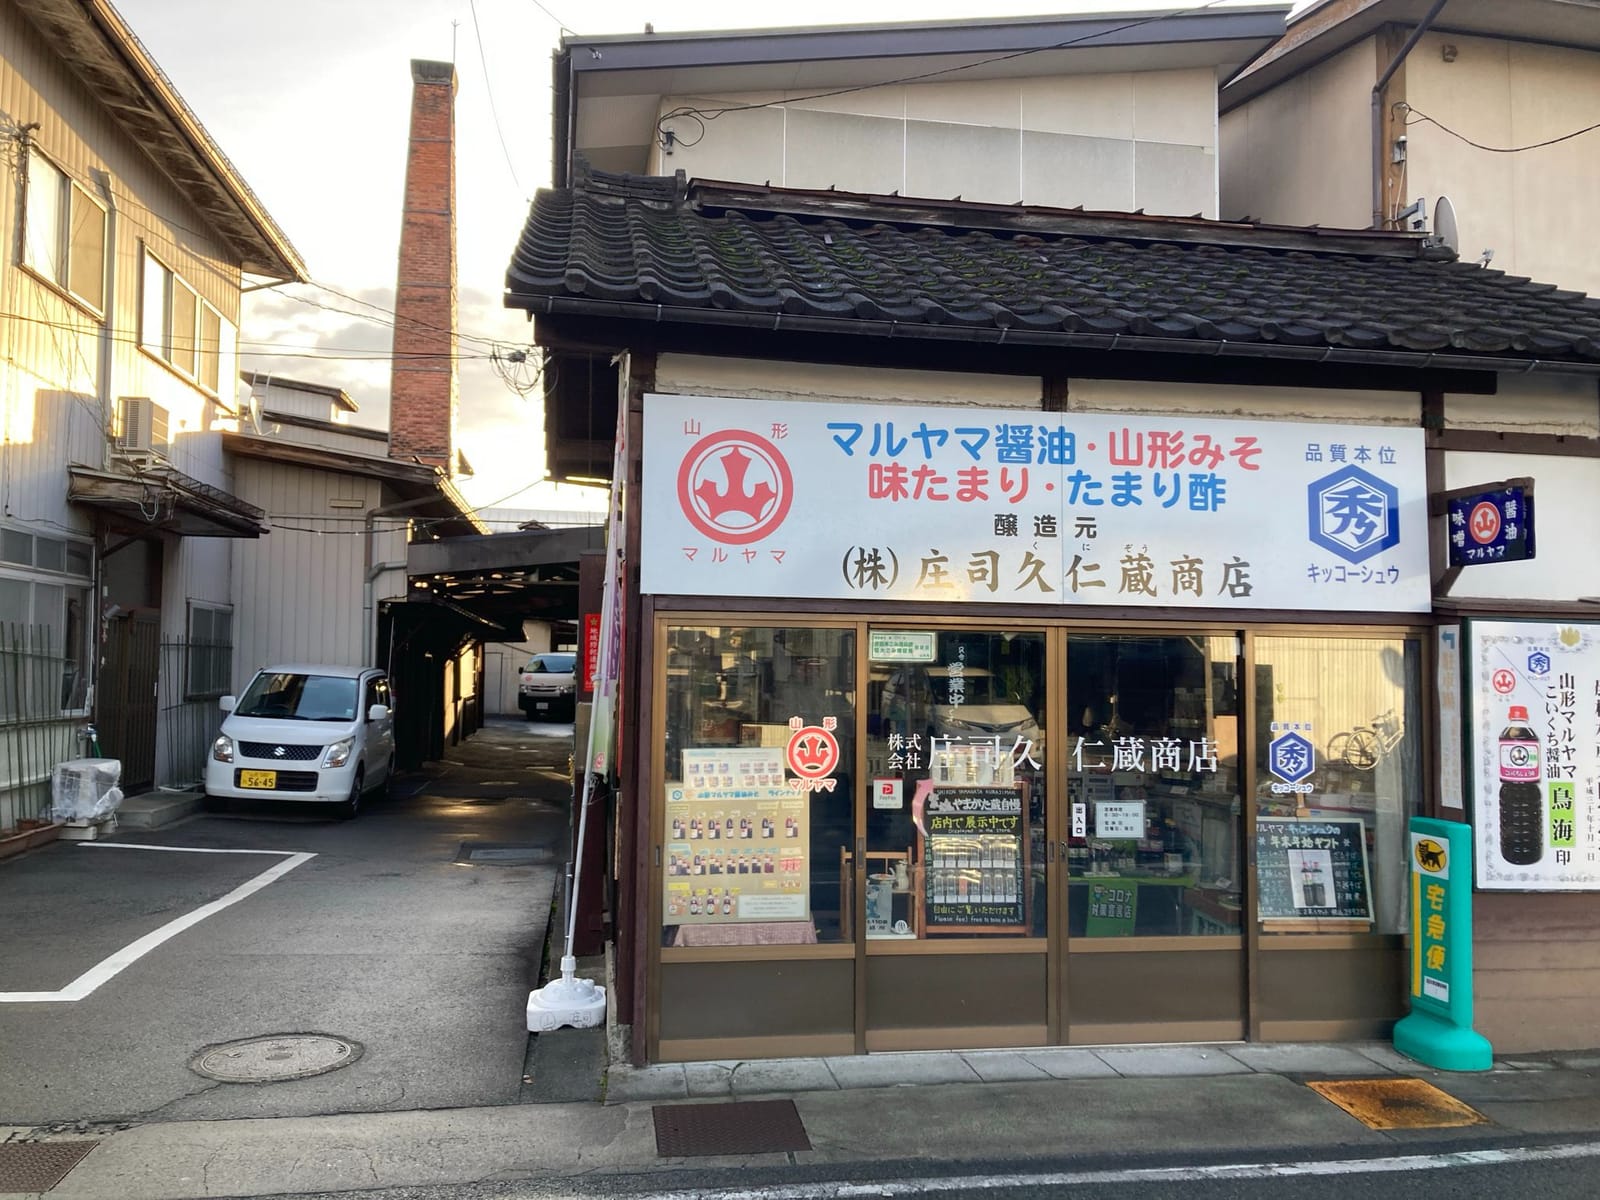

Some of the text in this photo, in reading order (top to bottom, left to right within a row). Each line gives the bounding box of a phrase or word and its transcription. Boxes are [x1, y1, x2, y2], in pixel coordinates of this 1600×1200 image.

[826, 422, 1263, 471] マルヤマ醤油・山形みそ
[1305, 443, 1397, 465] 品質本位
[868, 462, 1227, 512] 味たまり・たまり酢
[994, 513, 1098, 539] 醸造元
[1324, 485, 1384, 544] 秀
[682, 546, 787, 564] マルヤマ
[1466, 545, 1505, 559] マルヤマ
[1307, 563, 1400, 584] キッコーシュウ
[947, 661, 966, 709] 営業中
[1545, 685, 1561, 779] こいくち醤油
[1559, 672, 1577, 779] 山形マルヤマ
[789, 779, 837, 792] マルヤマ
[1272, 783, 1314, 793] キッコーシュウ
[1075, 806, 1083, 834] 出入口
[1426, 884, 1447, 972] 宅急便
